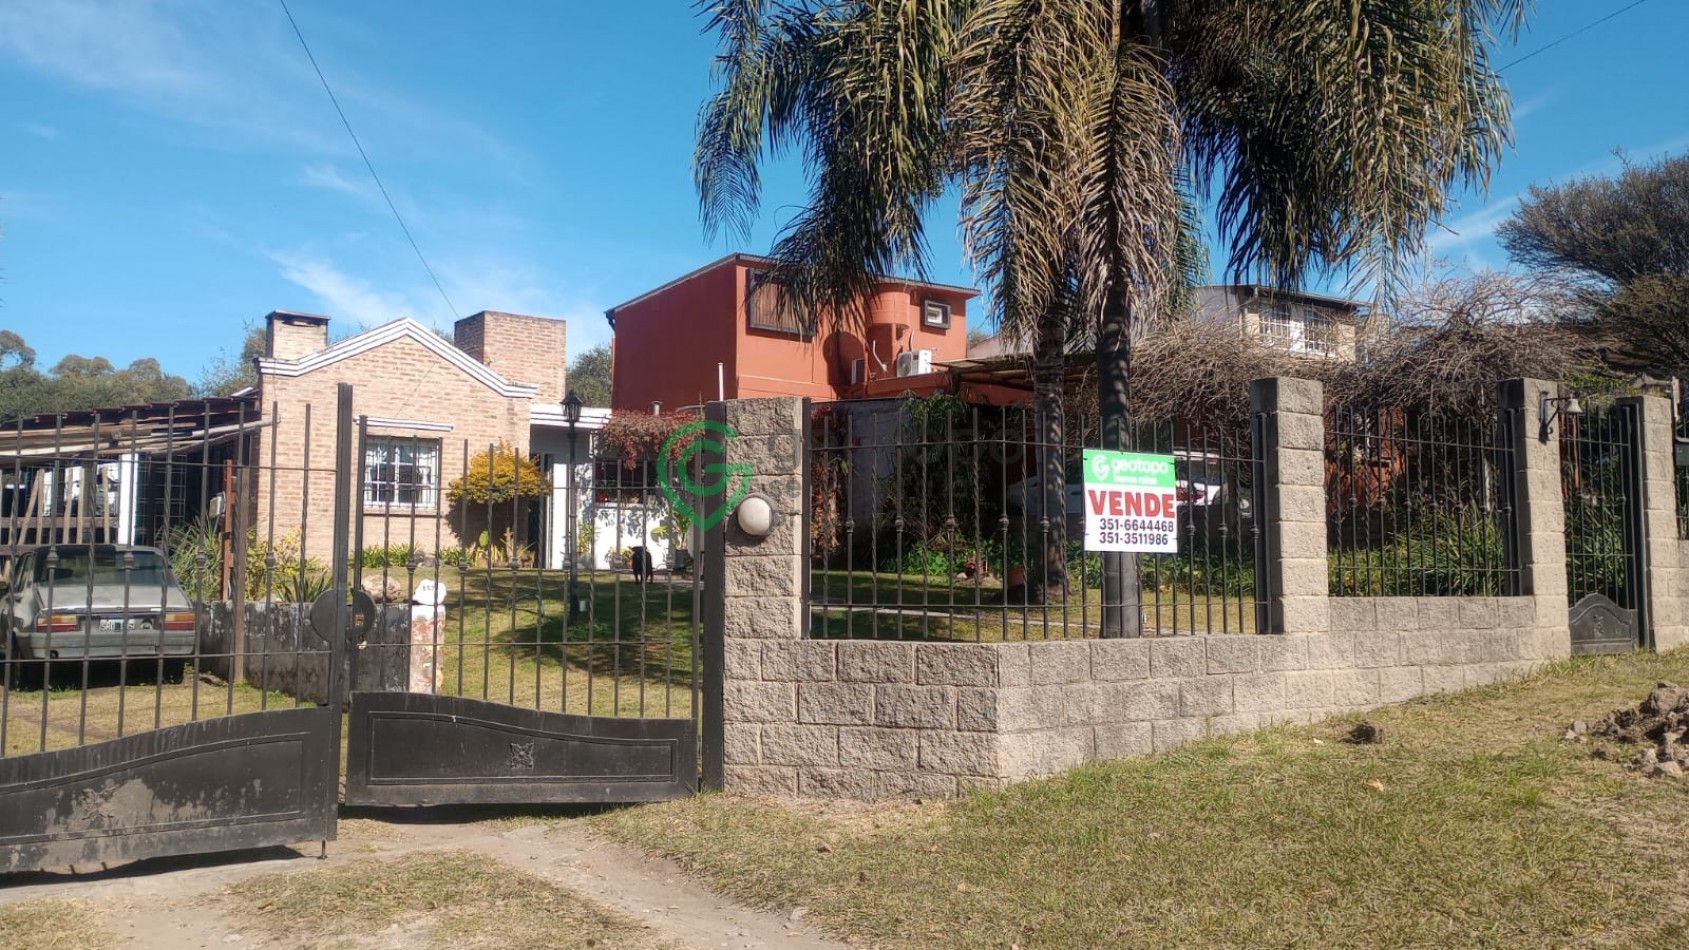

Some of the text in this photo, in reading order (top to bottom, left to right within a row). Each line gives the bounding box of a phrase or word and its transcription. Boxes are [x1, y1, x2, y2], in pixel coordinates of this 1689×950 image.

[1111, 458, 1168, 476] geotopo
[1088, 490, 1175, 518] VENDE
[1099, 518, 1174, 532] 351-6644468
[1099, 532, 1168, 545] 351-3511986
